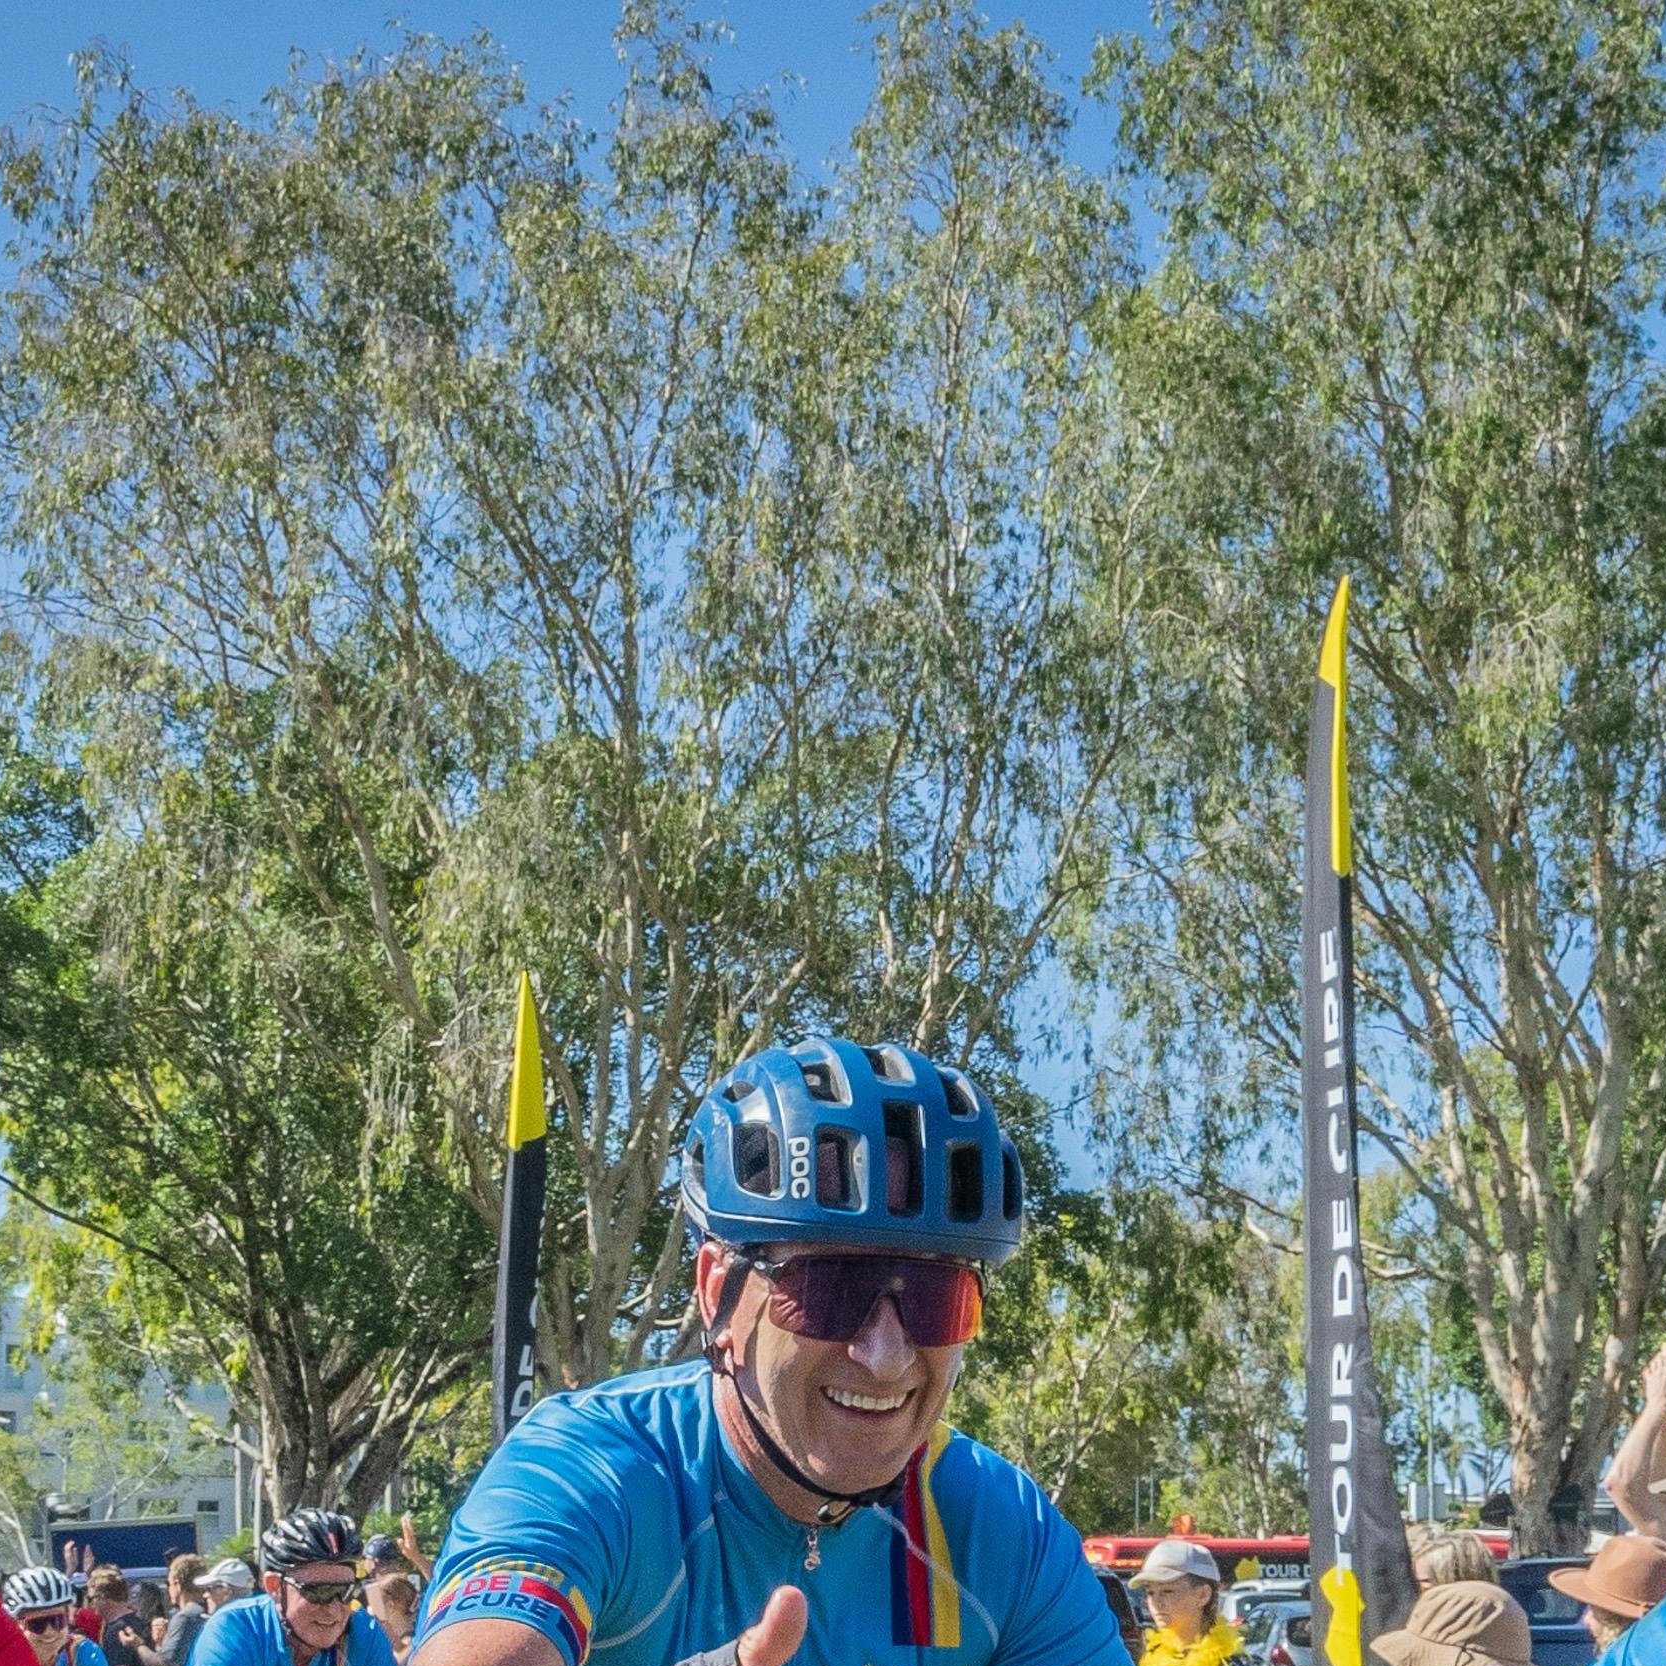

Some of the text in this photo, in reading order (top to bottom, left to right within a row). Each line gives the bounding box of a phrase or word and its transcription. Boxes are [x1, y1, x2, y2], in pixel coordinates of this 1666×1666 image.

[1332, 1197, 1353, 1317] DE
[1258, 1563, 1311, 1578] TOUR D
[462, 1574, 511, 1596] DE
[455, 1592, 555, 1621] CURE
